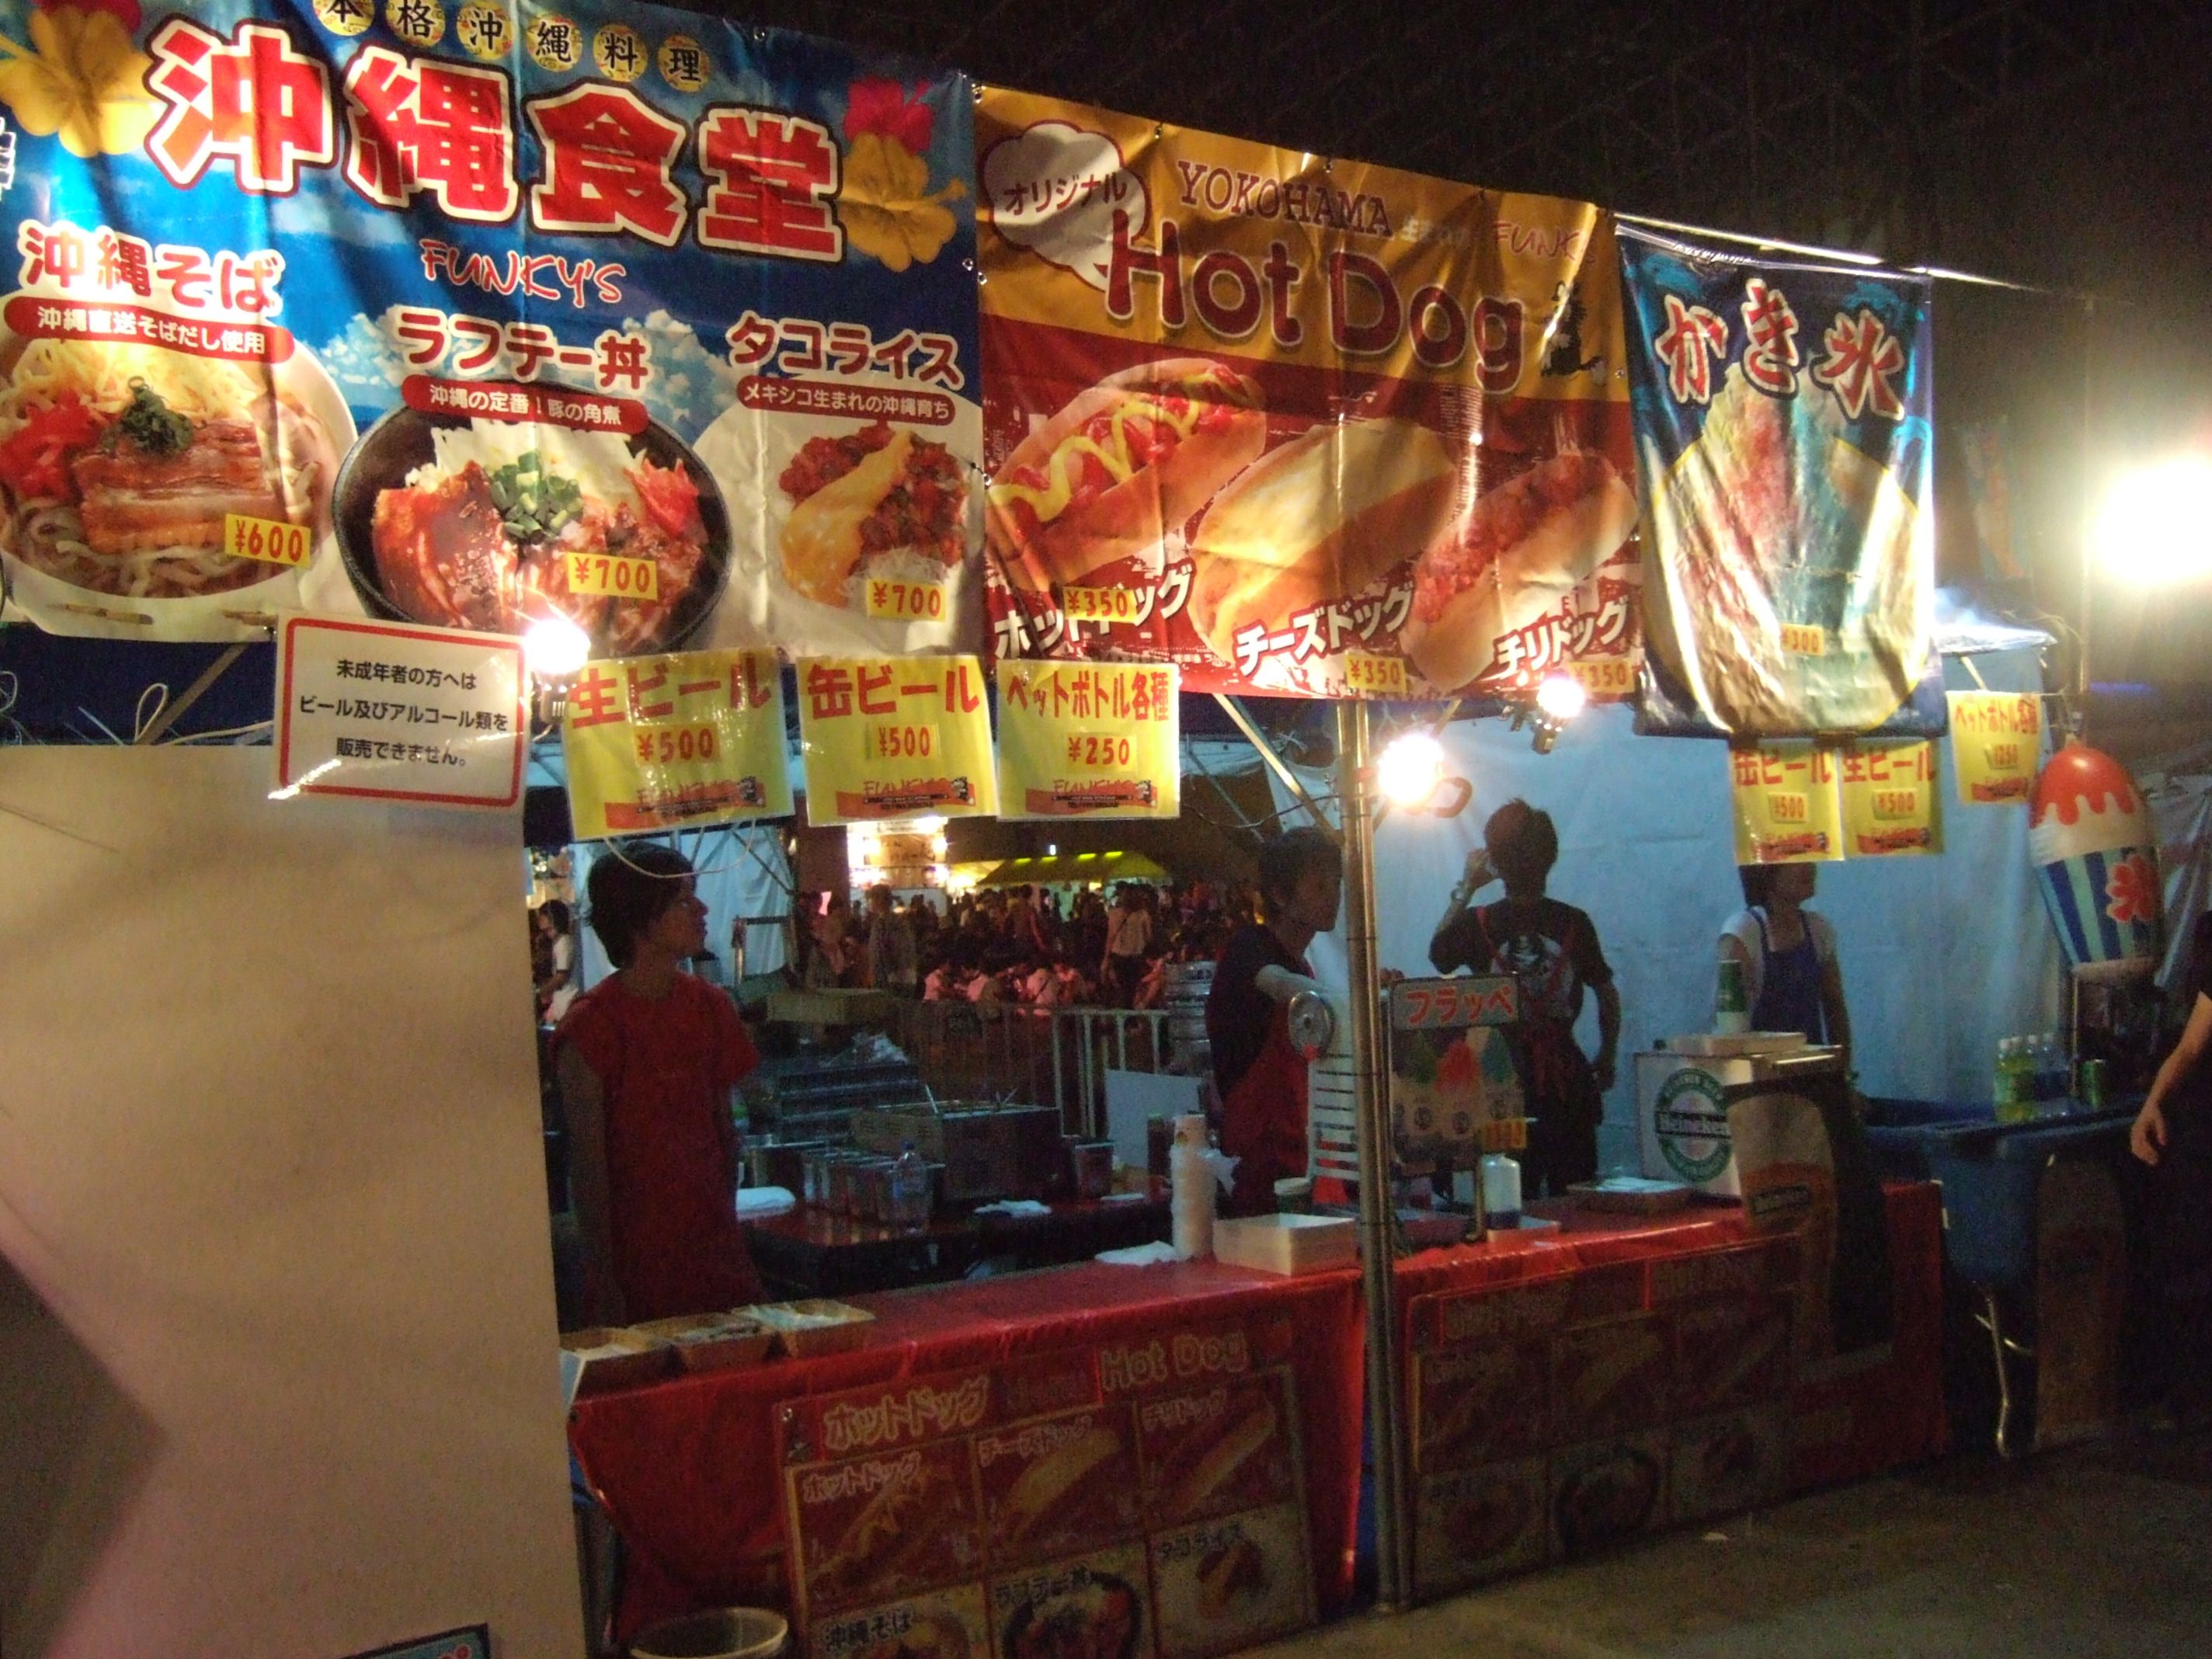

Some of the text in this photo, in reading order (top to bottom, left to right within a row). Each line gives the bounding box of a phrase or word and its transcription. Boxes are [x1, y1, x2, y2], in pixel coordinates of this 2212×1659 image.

[323, 0, 702, 82] 本格沖縄料理
[151, 22, 842, 259] 沖縄食堂
[1002, 171, 1128, 216] オリジナル
[1177, 160, 1393, 238] YOKOHAMA
[20, 222, 283, 315] 沖縄そば
[420, 237, 627, 308] FUNKY'S
[1106, 208, 1525, 395] Hot Dog
[37, 305, 266, 356] 沖縄直送そばだし使用
[396, 309, 651, 391] ラフテー丼
[729, 313, 962, 388] タコライス
[1656, 279, 1905, 421] かき氷
[743, 383, 950, 419] メキシコ生まれの沖縄育ち
[235, 520, 304, 563] ¥600
[574, 556, 651, 593] ¥700
[871, 581, 942, 617] ¥700
[1066, 590, 1129, 617] ¥350
[1236, 584, 1414, 677] チーズドッグ
[1497, 595, 1629, 678] チリドッグ
[336, 659, 477, 690] 未成年者の方へは
[569, 652, 772, 729] 生ビール
[807, 663, 980, 720] 缶ビール
[1348, 659, 1400, 686] ¥350
[300, 694, 509, 732] ビール及びアルコール類を
[336, 737, 466, 767] 販売できません。
[637, 727, 714, 763] ¥500
[878, 725, 931, 758] ¥500
[1068, 737, 1130, 767] ¥250
[1734, 749, 1831, 786] 缶ビール
[1842, 746, 1936, 784] 生ビール
[1406, 985, 1515, 1027] フラッペ
[1100, 1340, 1167, 1391] Hot
[1172, 1330, 1248, 1376] Dog
